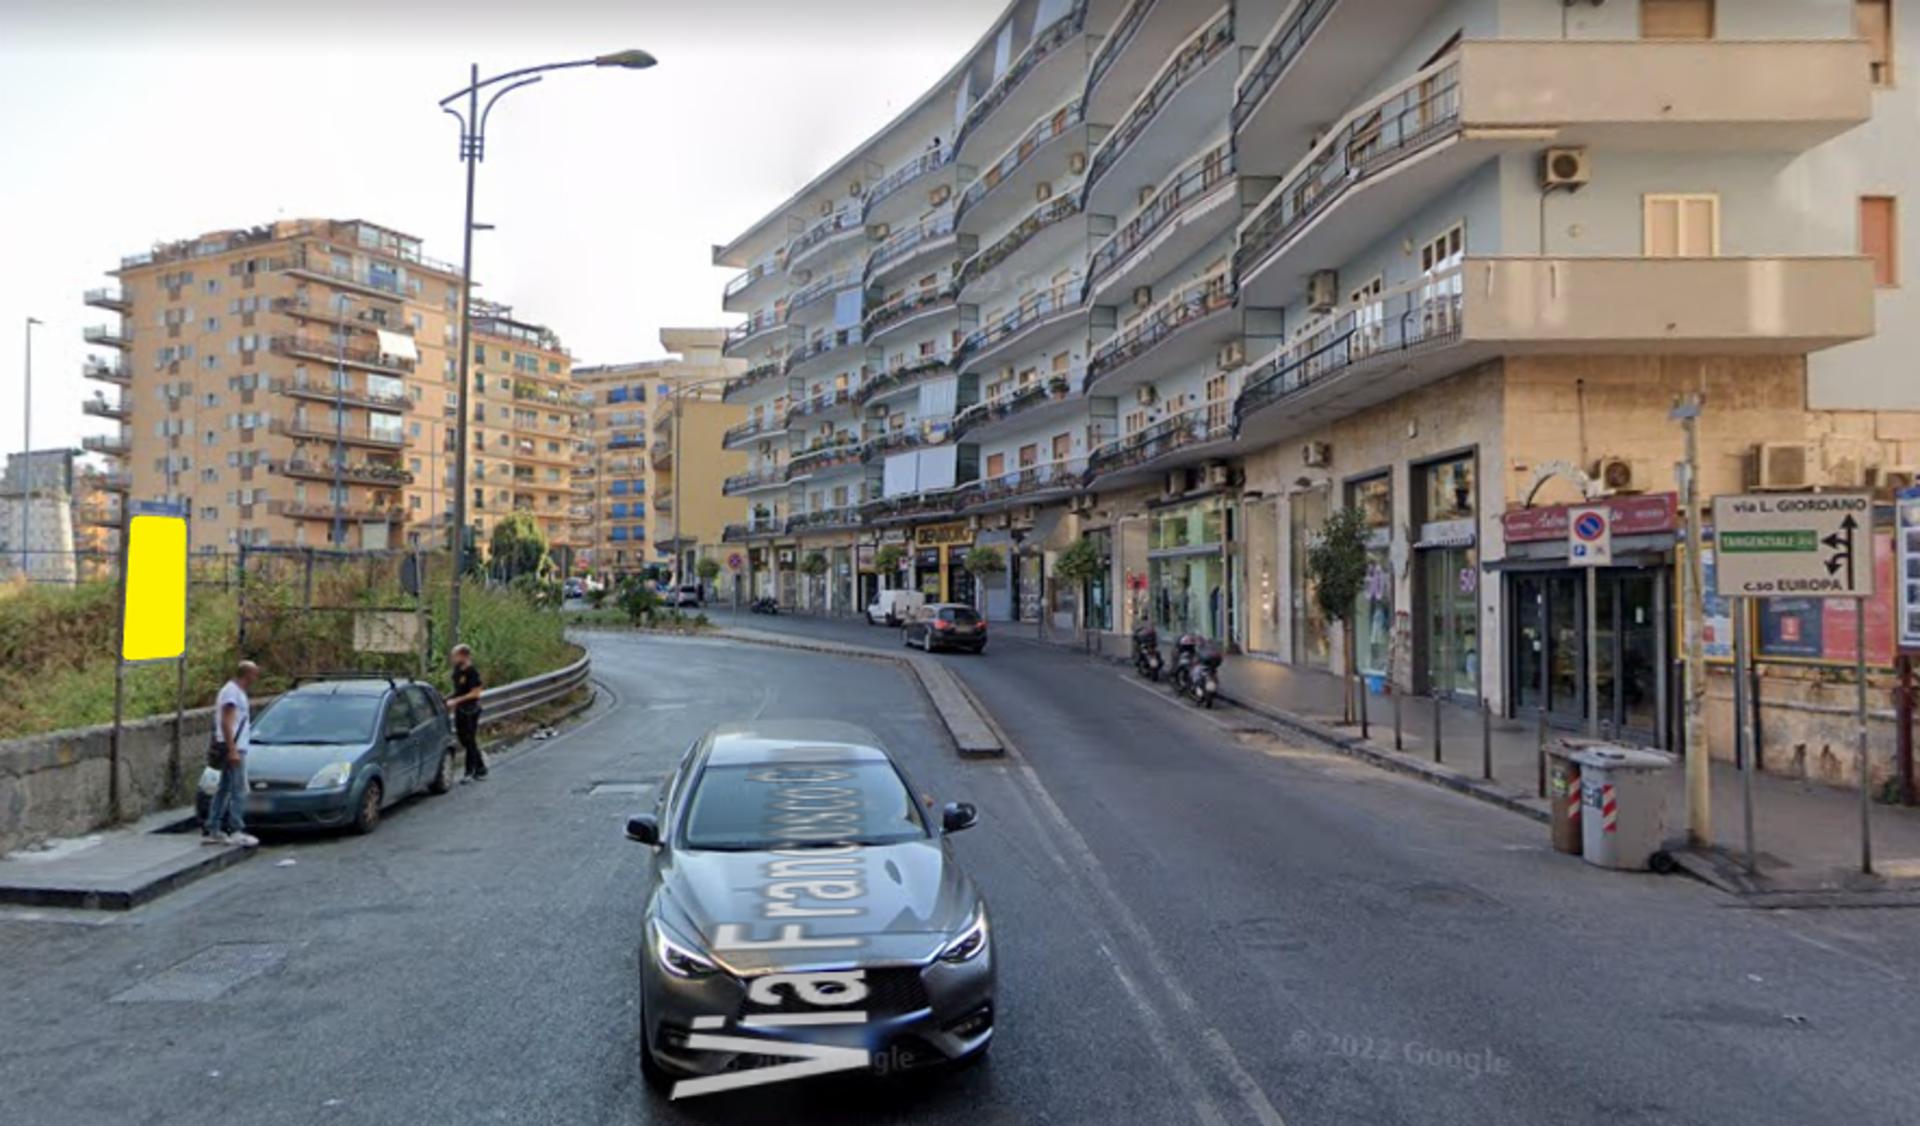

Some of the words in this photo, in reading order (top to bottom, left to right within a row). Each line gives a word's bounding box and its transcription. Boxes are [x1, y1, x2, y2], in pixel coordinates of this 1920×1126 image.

[1733, 500, 1757, 513] via
[1760, 500, 1774, 512] L.
[1776, 498, 1867, 512] GIORDANO
[1743, 580, 1774, 591] c.so
[1776, 578, 1843, 591] EUROPA
